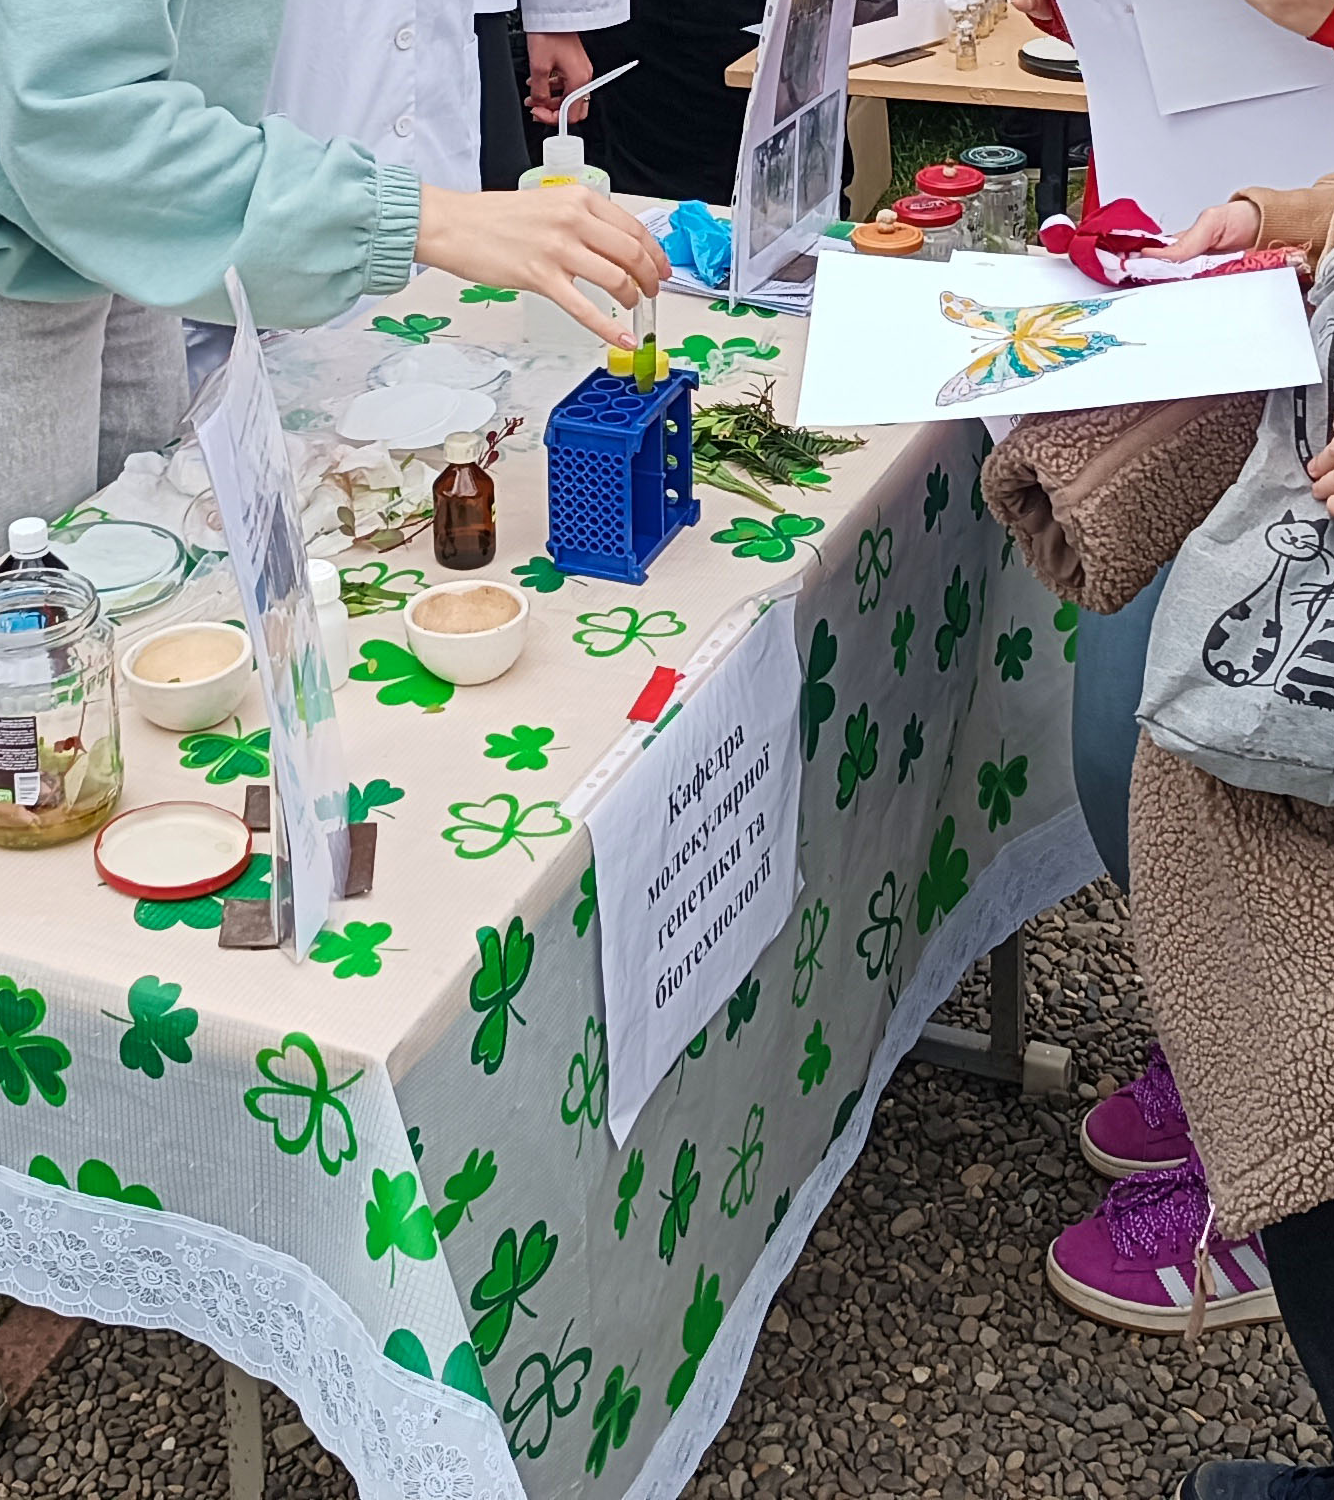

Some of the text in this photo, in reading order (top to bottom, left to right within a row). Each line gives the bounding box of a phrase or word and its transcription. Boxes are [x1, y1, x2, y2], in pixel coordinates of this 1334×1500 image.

[646, 743, 771, 911] молекулярної
[668, 722, 745, 828] Кафедра
[654, 847, 773, 1010] біотехнології
[657, 813, 766, 953] генетики та
